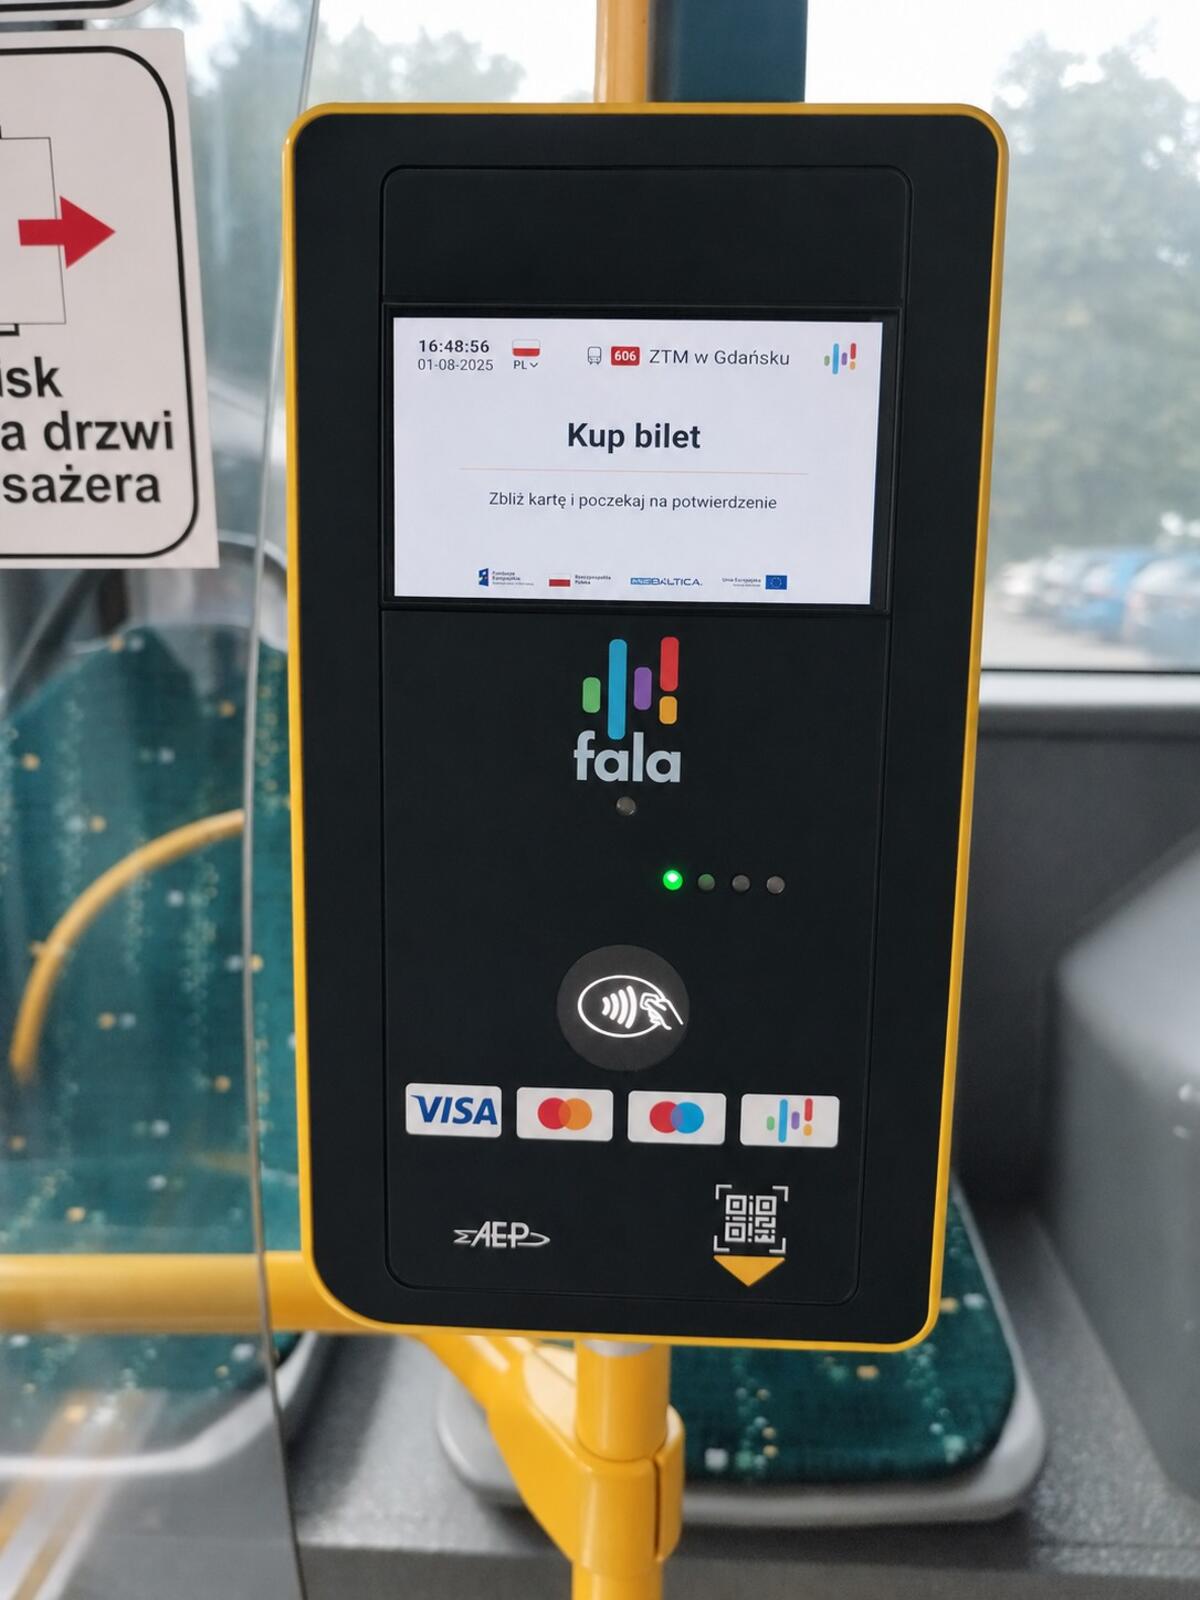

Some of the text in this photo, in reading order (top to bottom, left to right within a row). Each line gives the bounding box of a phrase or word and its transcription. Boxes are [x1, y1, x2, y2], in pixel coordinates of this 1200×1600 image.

[418, 339, 490, 353] 16:48:56
[613, 349, 790, 365] 606 ZTM w Gdańsku
[417, 358, 494, 371] 01-08-2025
[513, 360, 527, 370] PL
[43, 410, 174, 451] drzwi
[567, 422, 701, 453] Kup bilet
[489, 492, 777, 510] Zbliż kartę i poczekaj na potwierdzenie
[573, 730, 681, 783] fala
[411, 1094, 498, 1125] VISA
[471, 1221, 530, 1248] AEP
